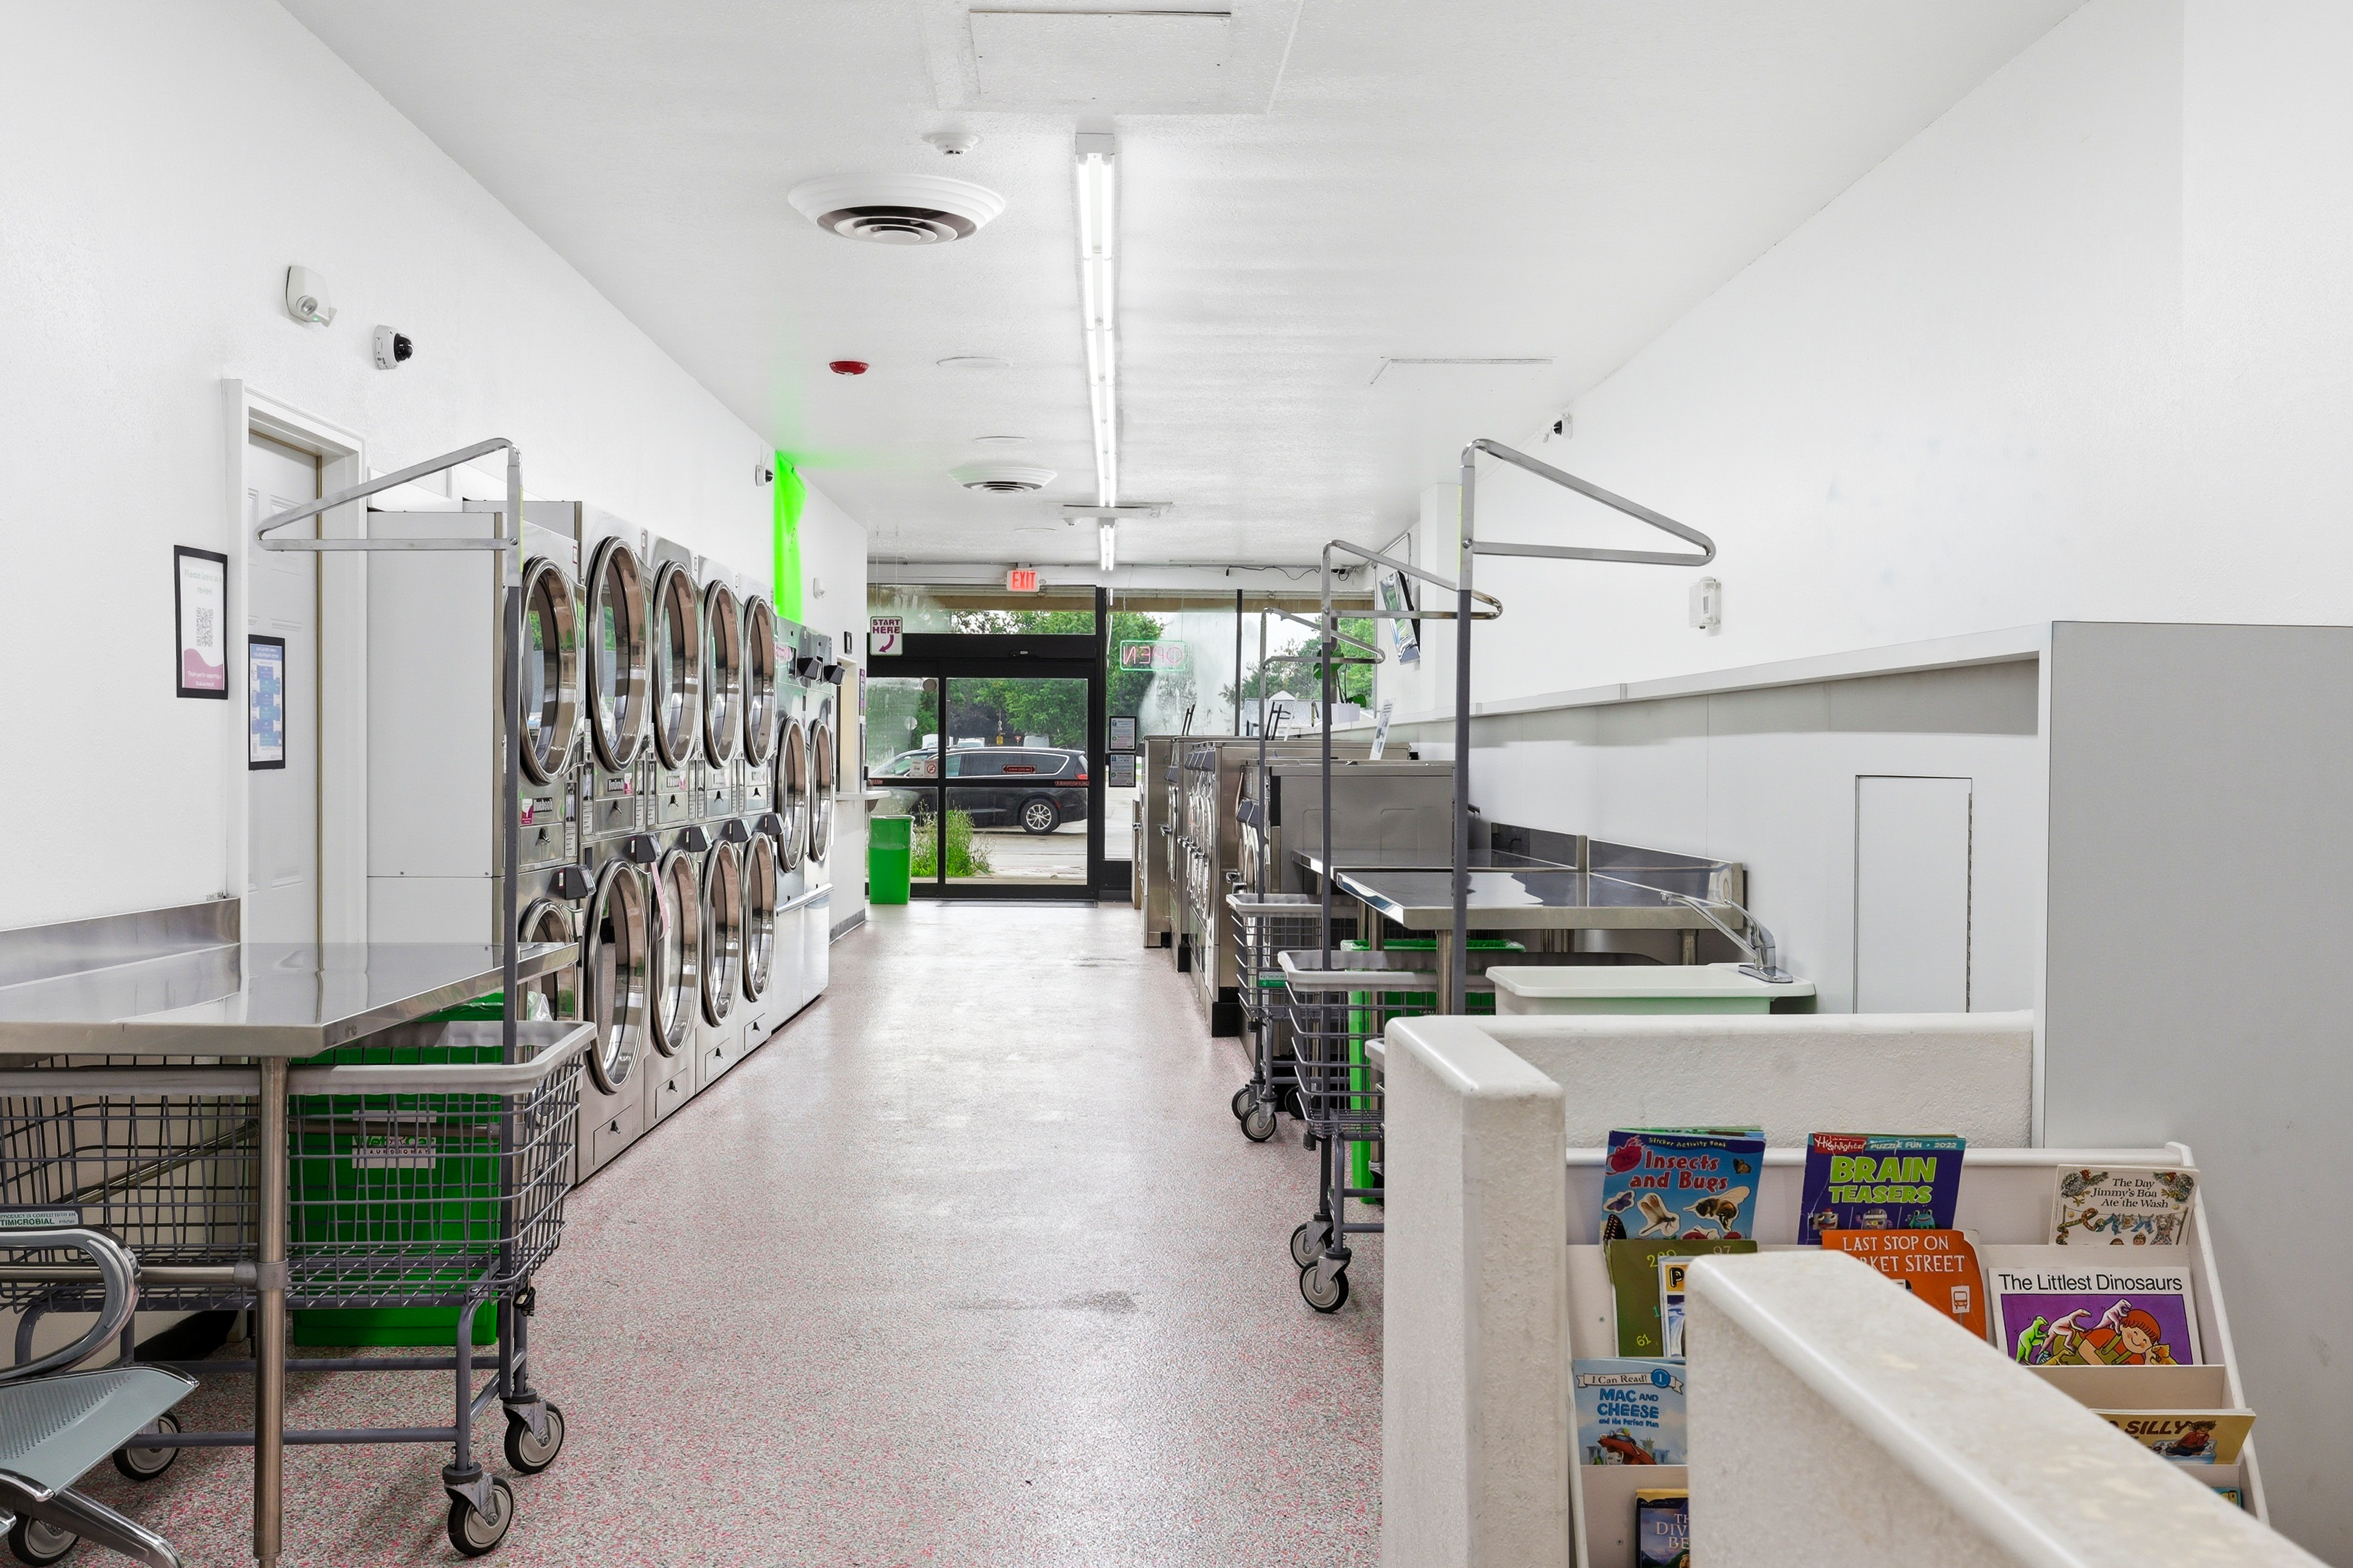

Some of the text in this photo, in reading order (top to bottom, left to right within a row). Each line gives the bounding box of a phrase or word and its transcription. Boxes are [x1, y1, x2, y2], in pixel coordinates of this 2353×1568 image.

[1011, 571, 1036, 590] EXIT
[1649, 1137, 1674, 1146] Sticker
[1870, 1140, 1902, 1149] PUZZLE
[1905, 1140, 1922, 1149] FUN
[1645, 1150, 1719, 1171] Insects
[1830, 1156, 1937, 1183] BRAIN
[1630, 1171, 1729, 1193] and Bugs
[2113, 1178, 2155, 1189] The Day
[1829, 1185, 1933, 1204] TEASERS
[2090, 1188, 2157, 1198] Jimmy's Boa
[2101, 1198, 2169, 1208] Ate the Wash
[1843, 1235, 1949, 1251] LAST STOP ON
[1860, 1255, 1964, 1272] RKET STREET
[1998, 1274, 2183, 1291] The Littlest Dinosaurs
[1636, 1334, 1651, 1346] 61
[1598, 1376, 1617, 1384] Can
[1620, 1374, 1648, 1383] Read!
[1599, 1388, 1659, 1402] MAC AND
[1597, 1402, 1659, 1419] CHEESE
[1623, 1418, 1643, 1427] Perfect
[2124, 1420, 2189, 1435] SILLY
[1674, 1513, 1689, 1524] TH
[1656, 1521, 1690, 1536] DIV
